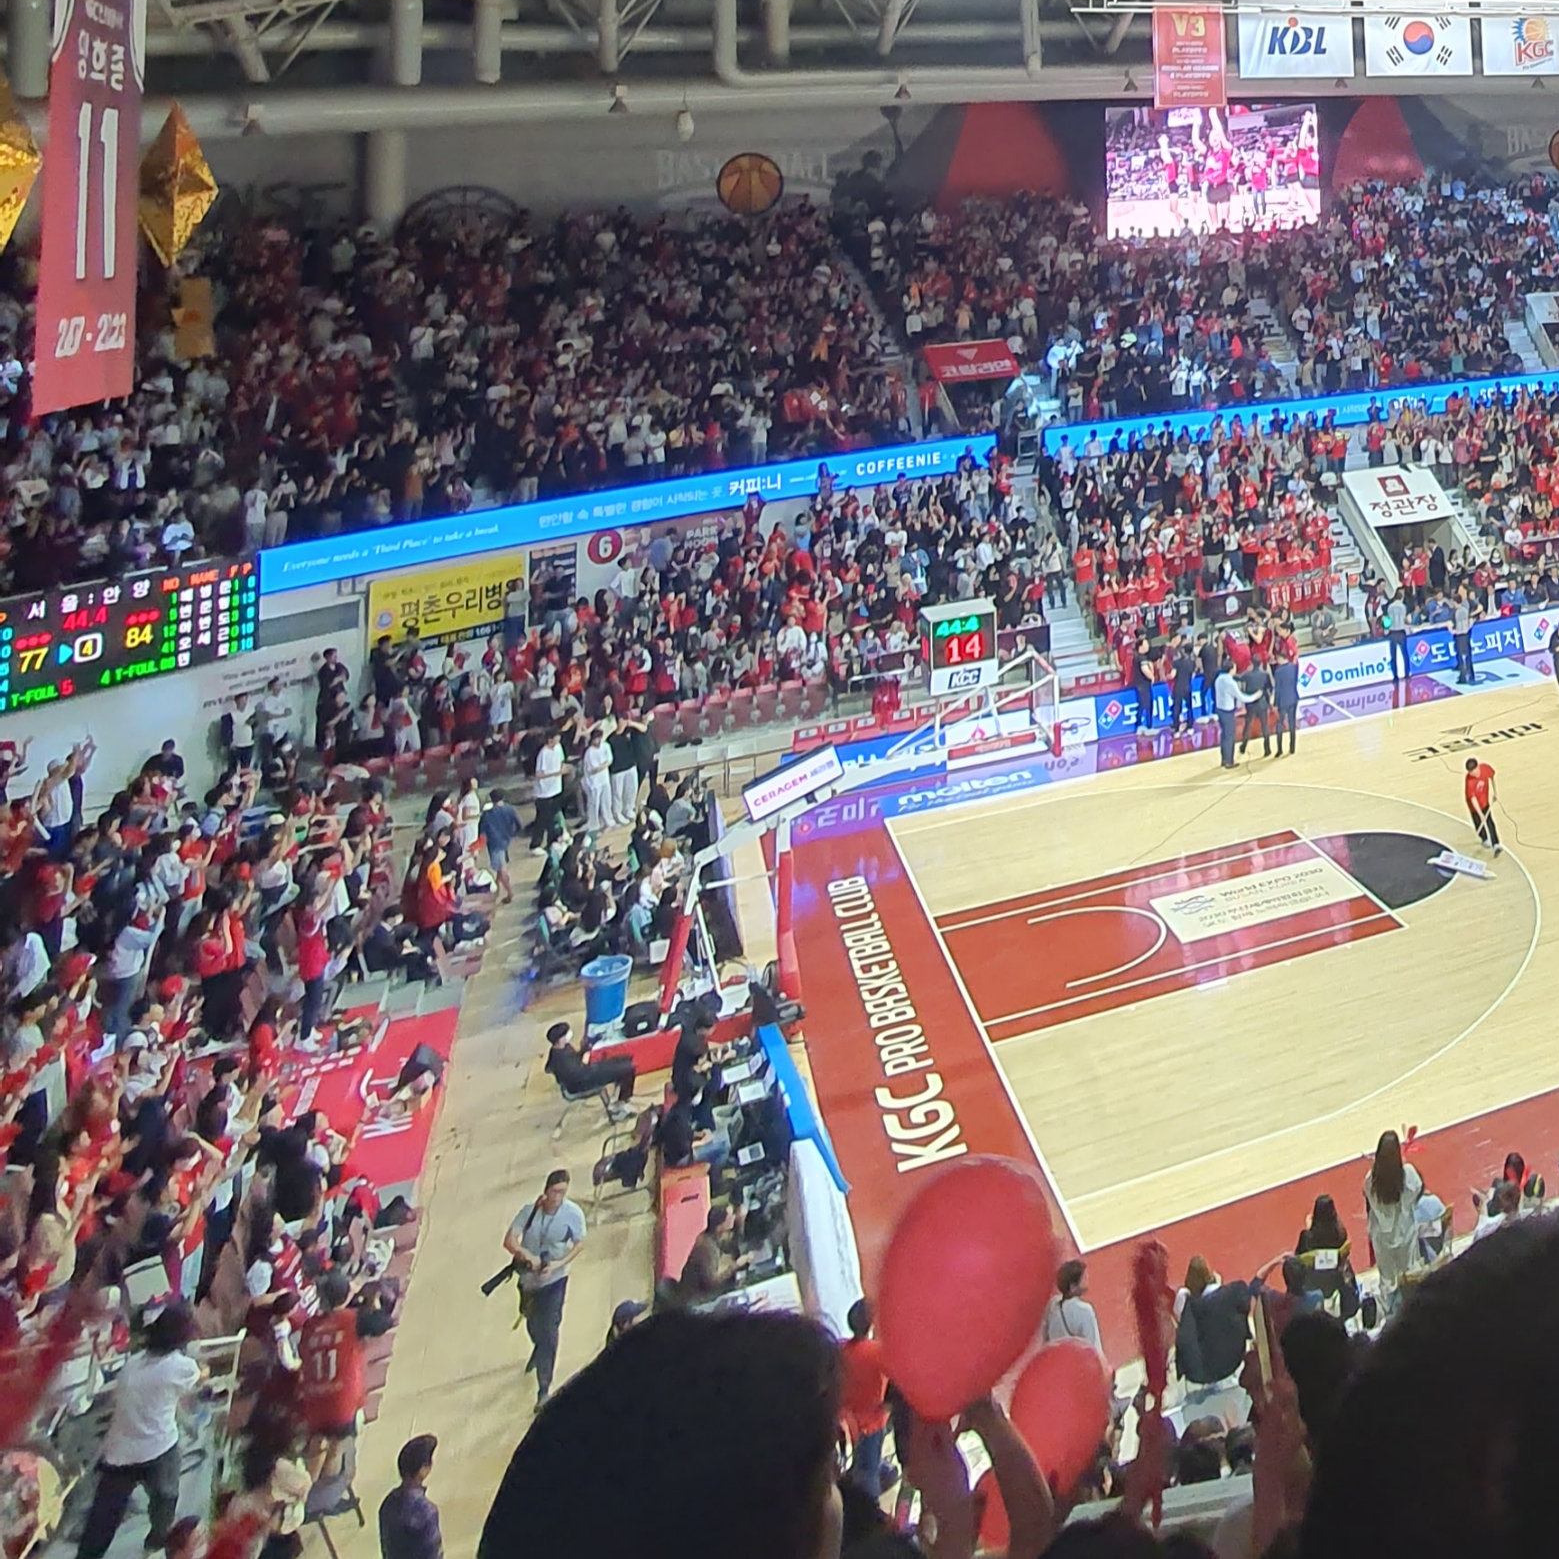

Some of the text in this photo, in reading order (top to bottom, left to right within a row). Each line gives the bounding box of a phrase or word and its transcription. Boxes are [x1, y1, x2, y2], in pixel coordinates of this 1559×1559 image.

[1171, 13, 1206, 37] V3
[1267, 21, 1327, 56] KBL
[1515, 39, 1554, 66] KGC
[75, 102, 120, 281] 11
[856, 451, 942, 477] COFFEENIE
[1369, 494, 1438, 518] 정관장
[686, 525, 718, 539] PARK
[597, 536, 614, 559] 6
[63, 606, 109, 631] 44.4
[163, 624, 178, 638] 12
[19, 646, 49, 674] 77
[82, 640, 93, 657] 4
[125, 623, 154, 649] 84
[160, 640, 176, 654] 41
[945, 633, 982, 664] 14
[11, 684, 59, 707] T-FOUL
[60, 679, 74, 695] 5
[100, 670, 111, 686] 4
[115, 659, 159, 681] T-FOUL
[951, 668, 979, 687] KCC
[1320, 656, 1391, 685] Domino's
[753, 772, 808, 807] CERAGEM
[897, 768, 1034, 806] molten
[1219, 882, 1257, 898] World
[828, 875, 968, 1174] KGC PRO BASKETBALL CLUB
[312, 1349, 338, 1382] 11
